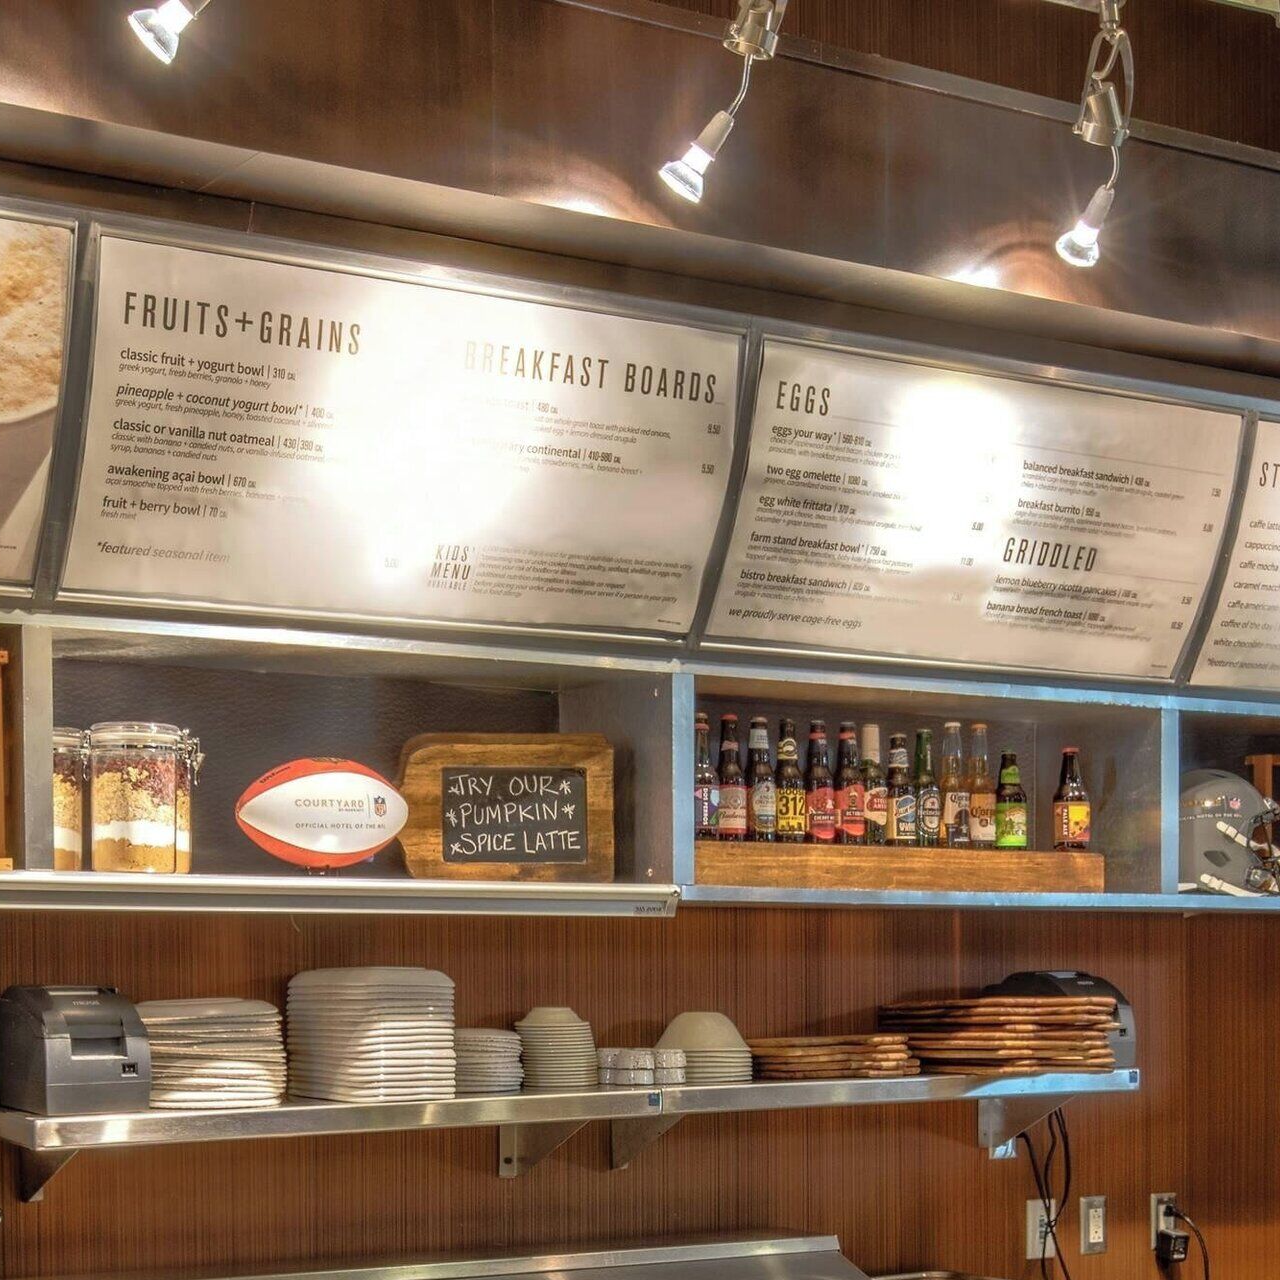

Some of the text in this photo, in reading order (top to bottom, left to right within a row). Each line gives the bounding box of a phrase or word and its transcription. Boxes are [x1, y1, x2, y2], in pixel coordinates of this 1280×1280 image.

[124, 291, 360, 355] FRUITS+GRAINS
[121, 348, 286, 380] classic fruit yogurt bowl 310
[464, 341, 716, 404] BREAKFAST BOARDS
[116, 383, 174, 402] pineapple
[186, 392, 231, 408] coconut
[232, 397, 269, 413] yogurt
[776, 380, 830, 416] EGGS
[113, 418, 275, 447] classic or vanilla nut oatmeal
[772, 424, 792, 437] eggs
[794, 427, 813, 439] your
[527, 444, 581, 459] continental
[108, 464, 225, 485] awakening açai bowl
[767, 464, 841, 483] two egg omelette
[102, 496, 201, 515] fruit berry bowl
[759, 495, 832, 512] egg white frittata
[750, 531, 772, 543] farm
[772, 535, 797, 545] stand
[798, 537, 838, 550] breakfast
[1003, 537, 1098, 572] GRIDDLED
[431, 562, 471, 580] MENU
[729, 608, 862, 628] we proudly serve cage-free eggs
[449, 774, 559, 796] TRY OUR
[295, 799, 364, 808] COURTYARD
[460, 800, 558, 828] PUMPKIN
[779, 796, 805, 816] 312
[460, 830, 580, 855] SPICE LATTE
